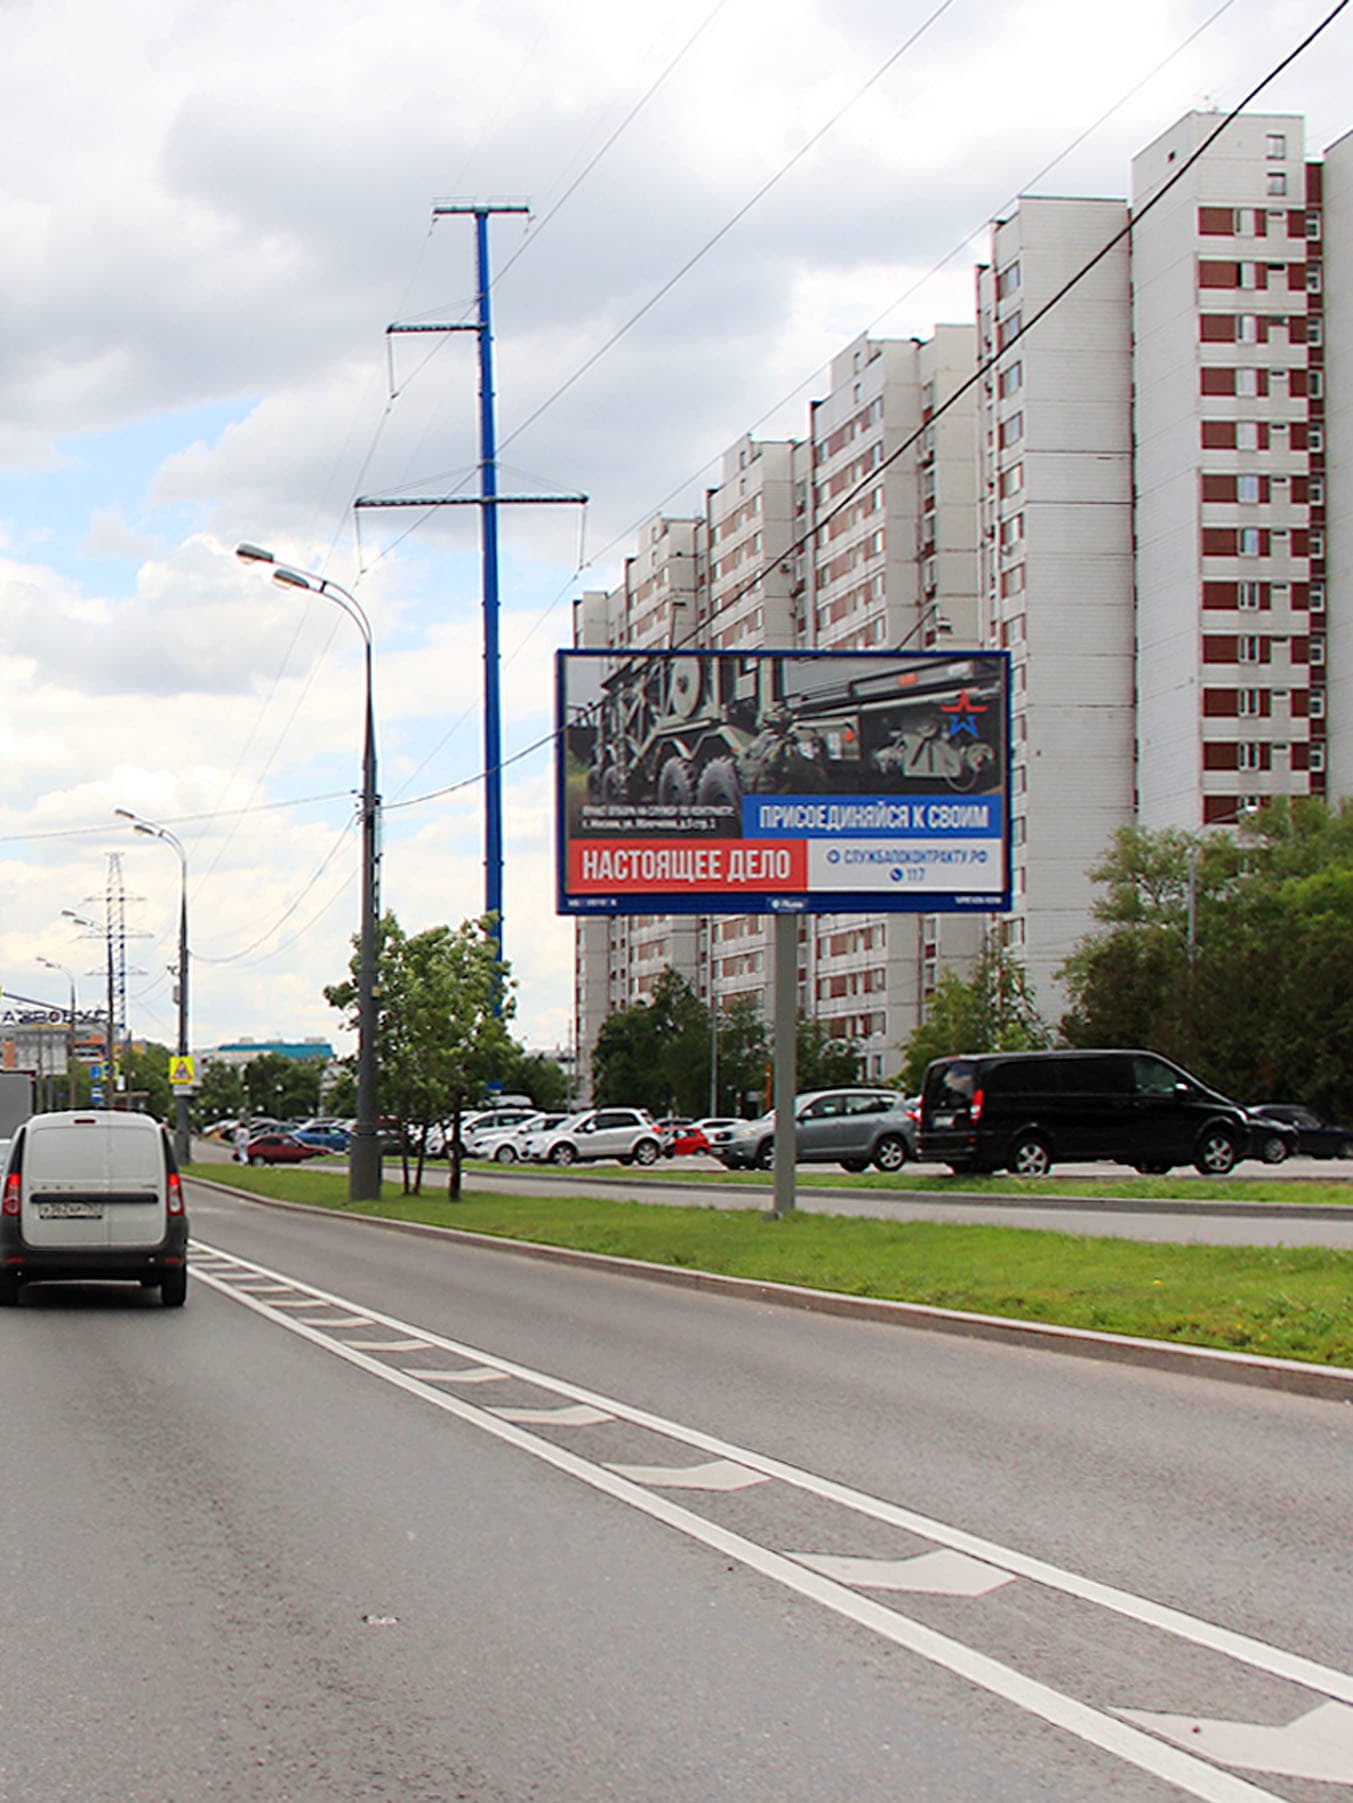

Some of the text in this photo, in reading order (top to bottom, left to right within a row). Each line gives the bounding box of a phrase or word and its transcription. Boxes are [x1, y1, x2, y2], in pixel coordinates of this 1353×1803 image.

[759, 801, 909, 831] ПРИСОЕДИНЯЙСЯ
[912, 805, 925, 828] К
[927, 805, 989, 828] СВОИМ
[582, 849, 792, 883] НАСТОЯЩЕЕ ДЕЛО
[906, 867, 926, 882] 117
